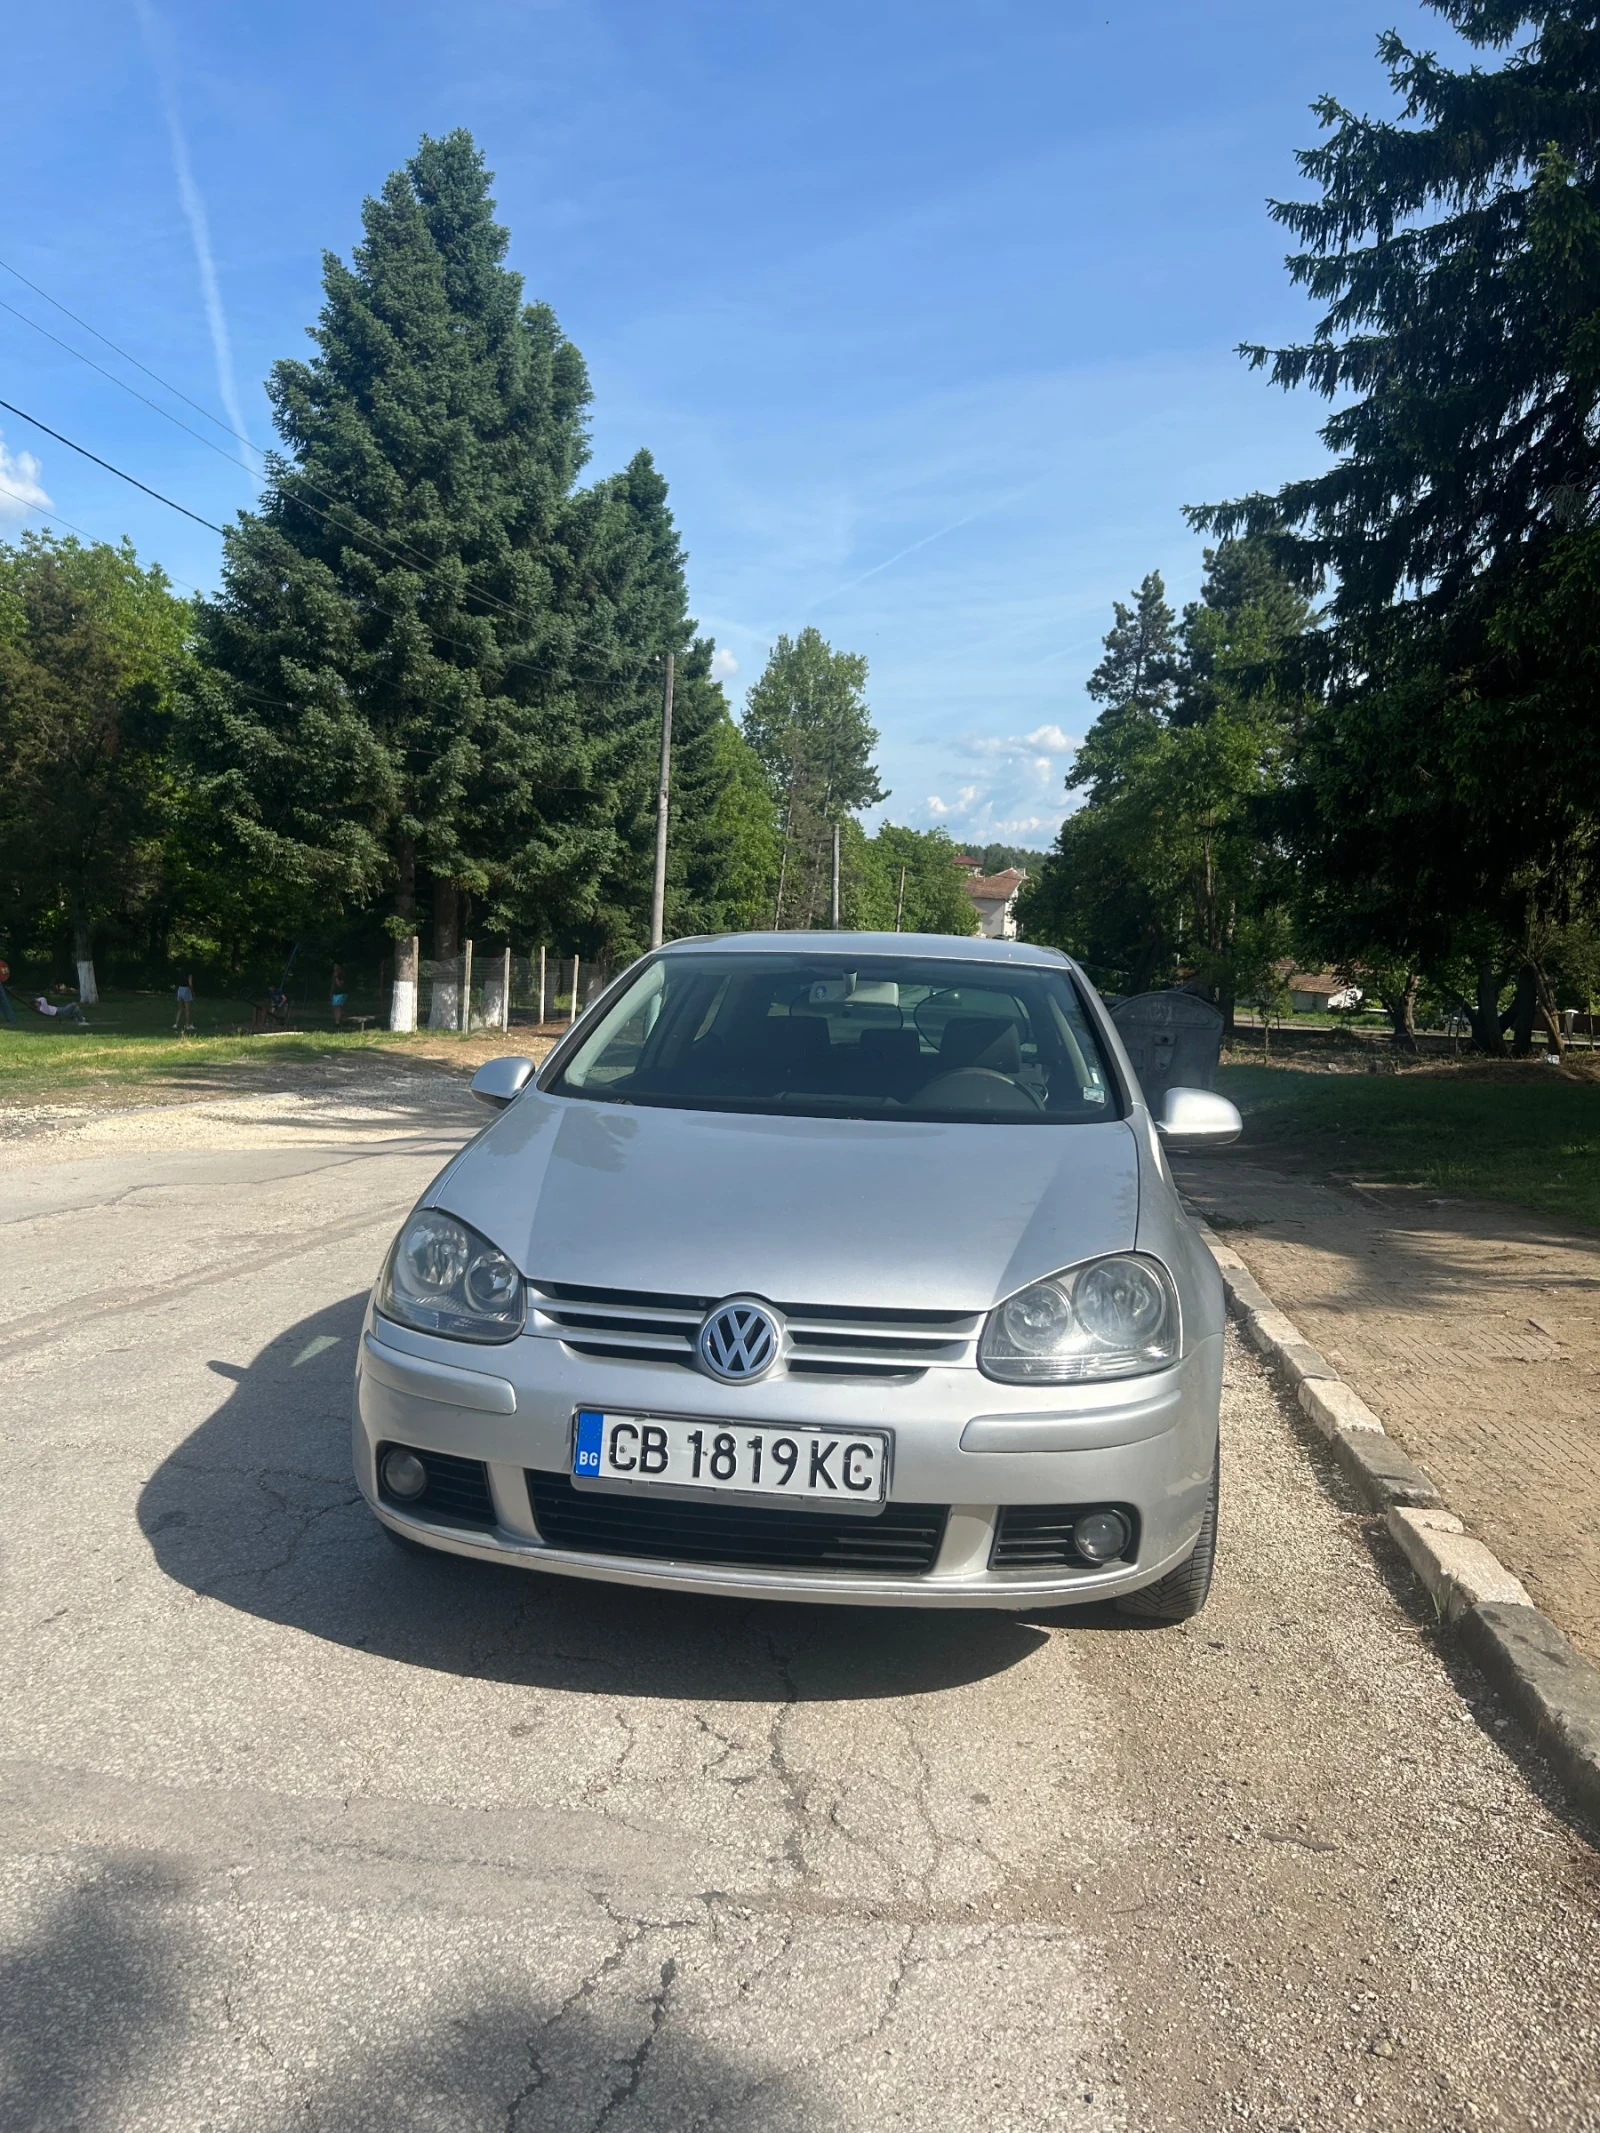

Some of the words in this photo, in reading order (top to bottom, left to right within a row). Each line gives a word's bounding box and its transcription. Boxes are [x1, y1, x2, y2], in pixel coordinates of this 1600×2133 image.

[704, 1304, 779, 1377] VW
[578, 1450, 598, 1467] BG
[609, 1423, 669, 1474] CB
